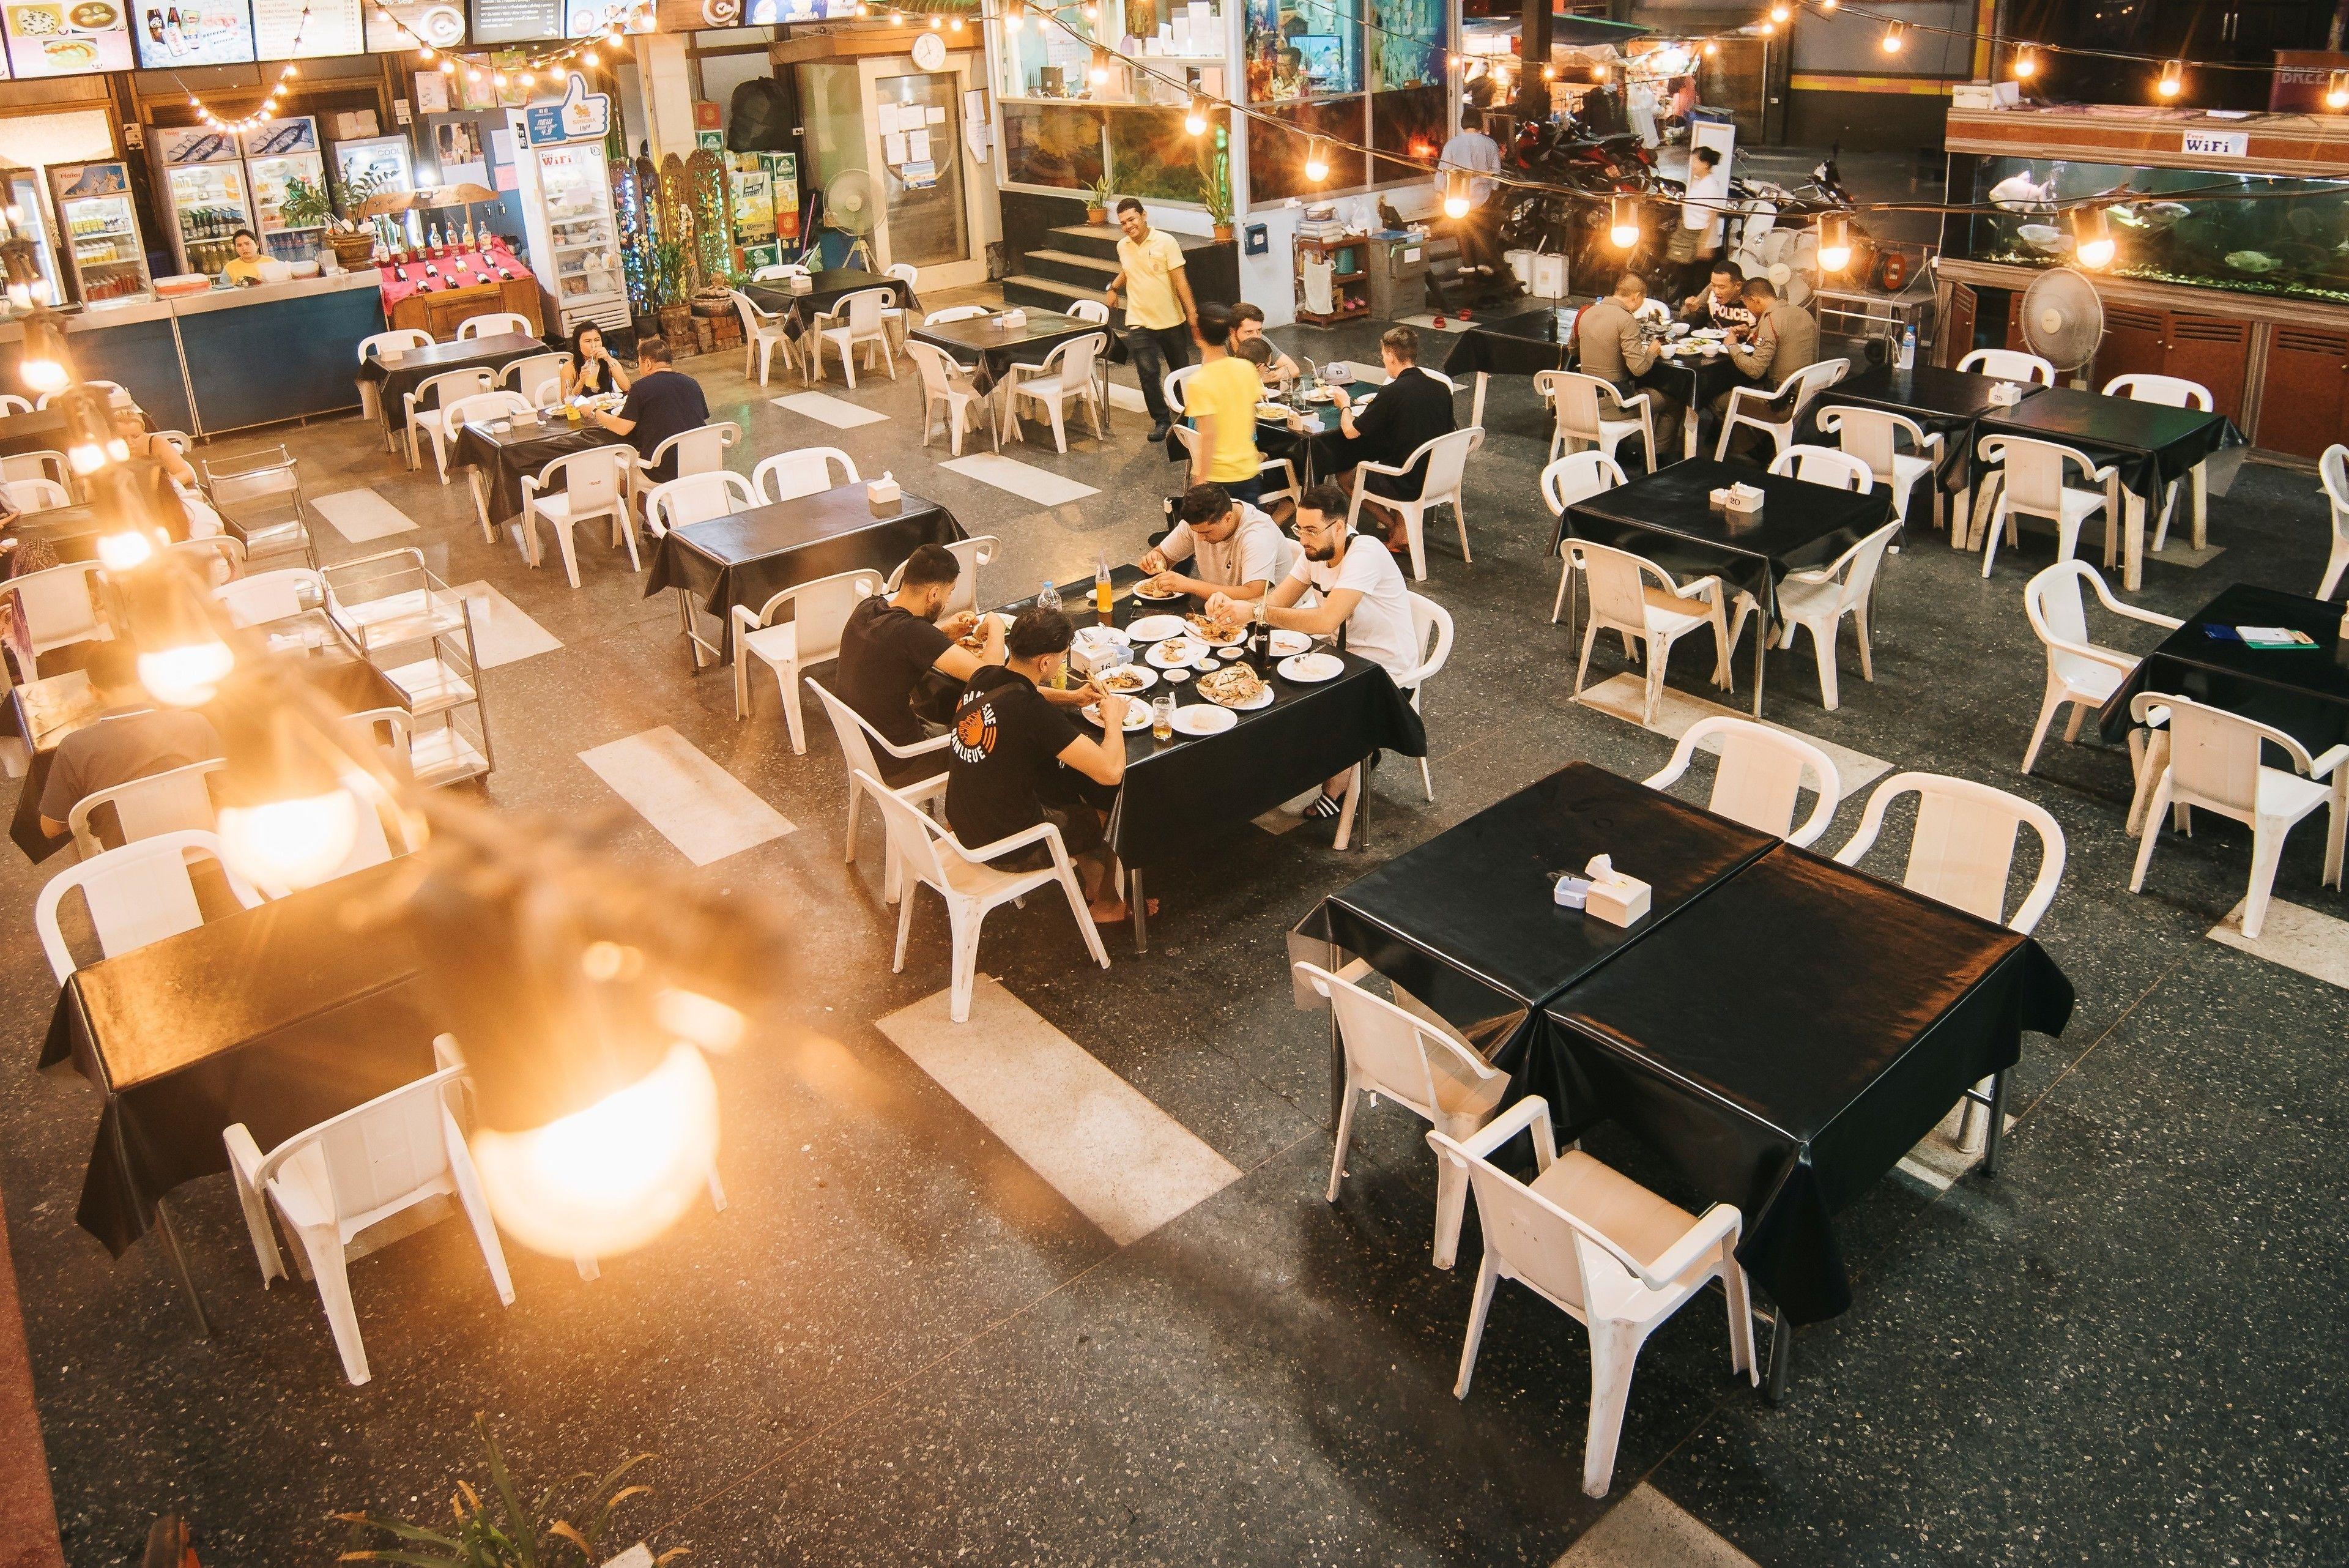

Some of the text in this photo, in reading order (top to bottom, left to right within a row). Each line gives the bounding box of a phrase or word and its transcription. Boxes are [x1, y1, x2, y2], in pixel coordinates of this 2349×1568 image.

[2187, 139, 2228, 152] WiFi
[542, 155, 572, 166] WiFi
[1713, 302, 1749, 322] POLICE
[1730, 497, 1740, 506] 20
[1101, 662, 1111, 671] 16
[951, 727, 986, 764] BANLIEUE
